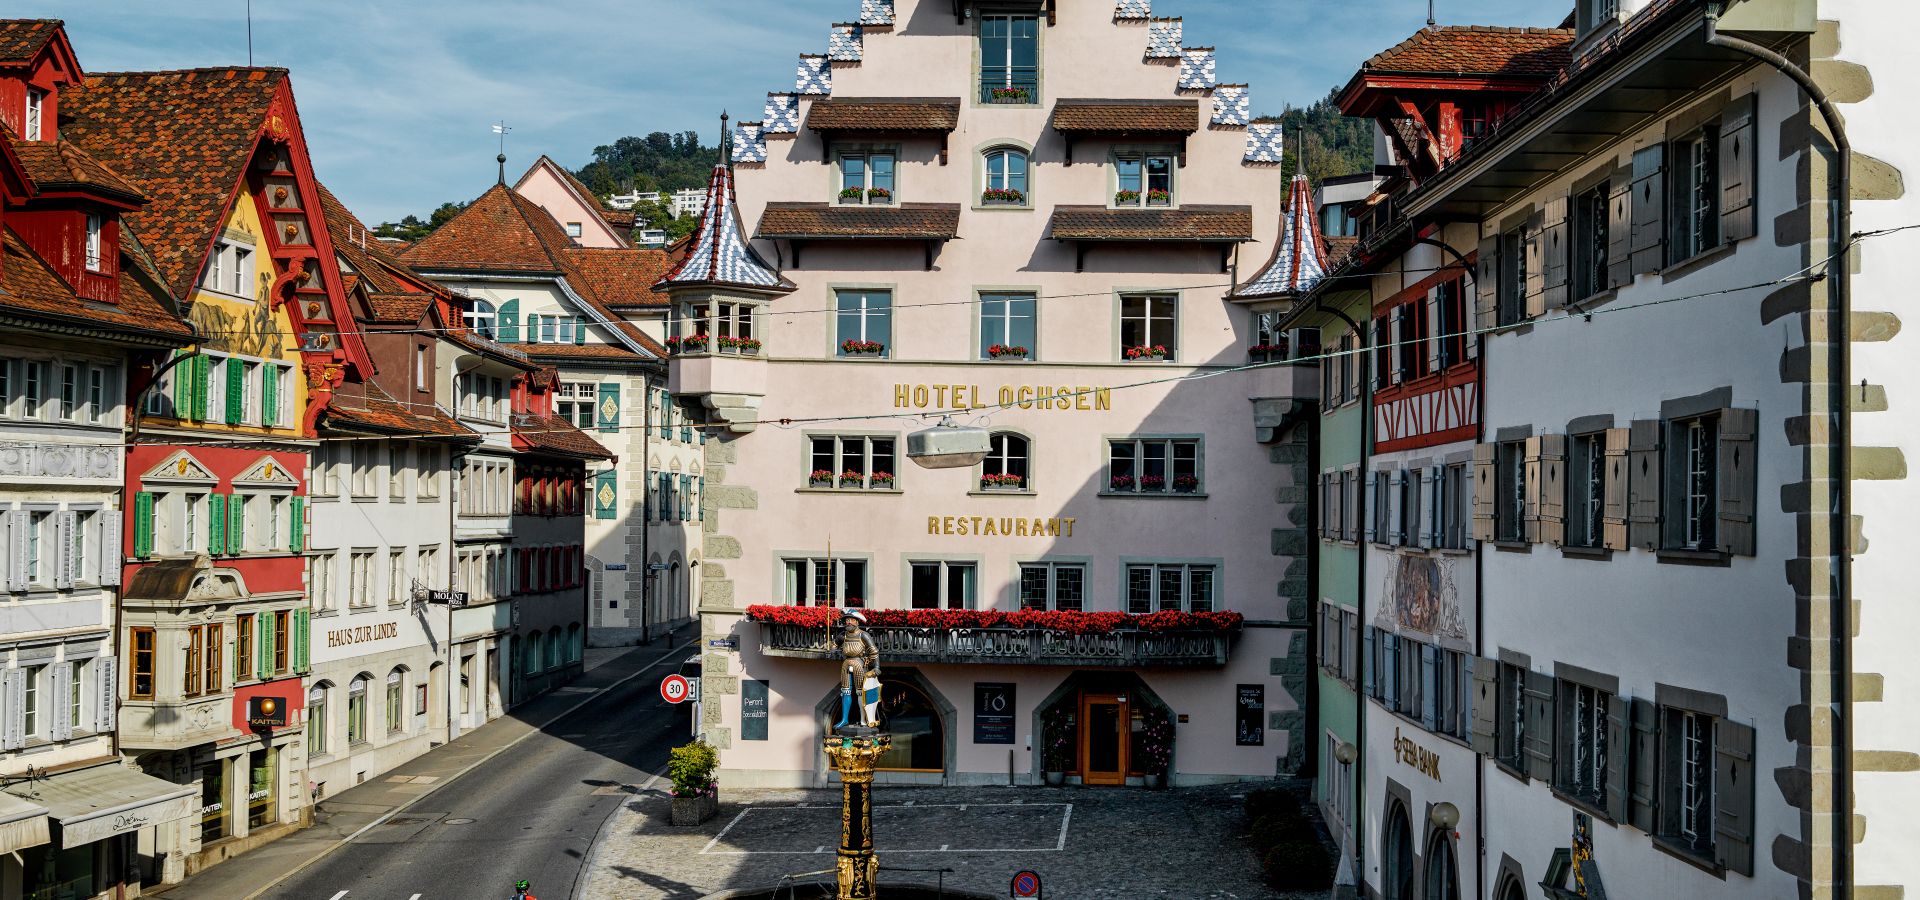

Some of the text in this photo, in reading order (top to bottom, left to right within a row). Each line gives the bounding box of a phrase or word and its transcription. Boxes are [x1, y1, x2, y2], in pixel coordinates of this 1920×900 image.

[894, 383, 1112, 411] HOTEL OCHSEN
[927, 515, 1076, 538] RESTAURANT
[433, 591, 464, 601] MOLINI
[328, 621, 398, 648] HAUS ZUR LINDE
[669, 684, 681, 694] 30
[1418, 745, 1442, 783] BANK
[249, 789, 269, 801] KAITEN
[202, 801, 223, 814] KAITEN
